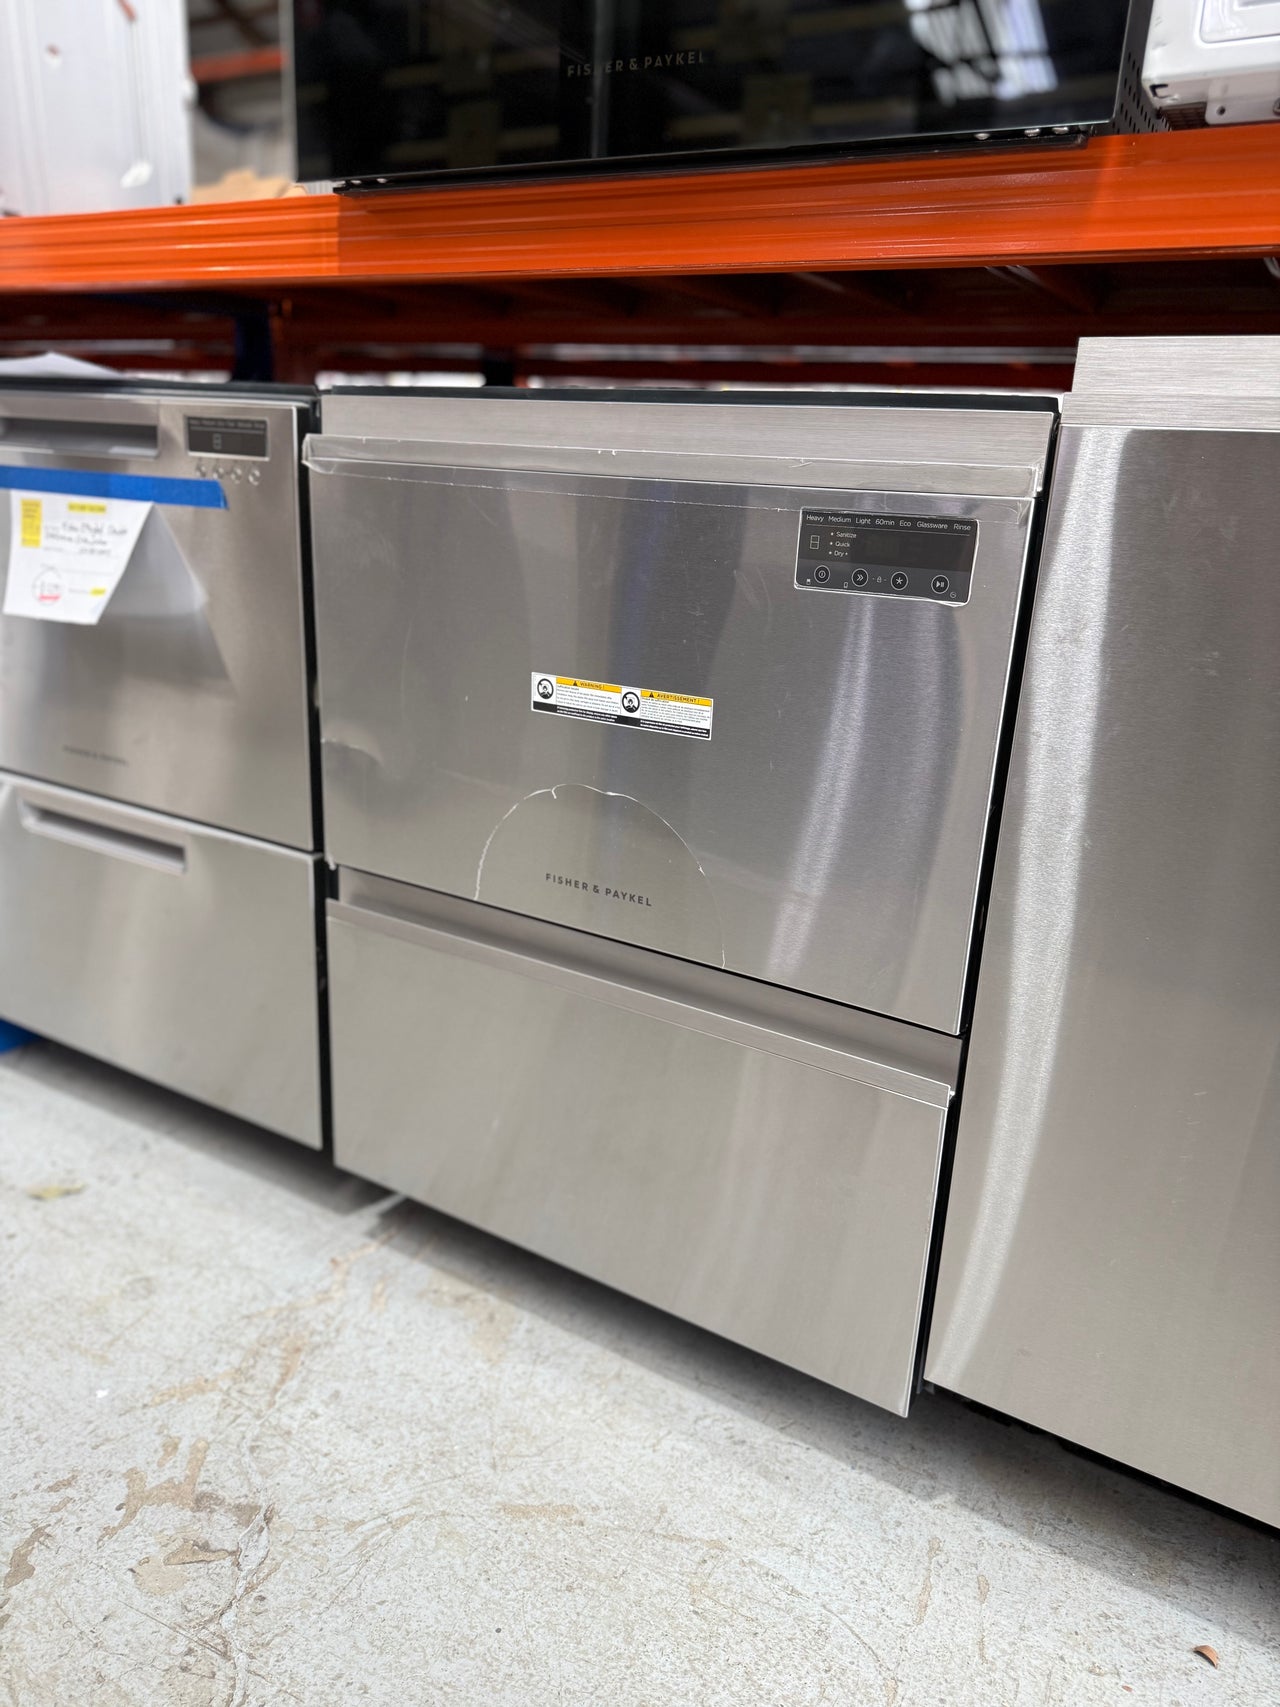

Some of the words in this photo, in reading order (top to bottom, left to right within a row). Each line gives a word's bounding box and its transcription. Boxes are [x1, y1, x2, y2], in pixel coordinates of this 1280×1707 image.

[567, 59, 623, 77] FISER
[629, 57, 639, 71] &
[644, 51, 704, 69] PAYKEL
[806, 514, 825, 523] Heavy
[828, 515, 852, 523] Medium
[875, 518, 895, 526] 60min
[899, 519, 912, 527] Eco
[916, 520, 948, 530] Glassware
[953, 523, 971, 531] Rinse
[836, 531, 857, 539] Sanitize
[835, 540, 850, 548] Quick
[545, 873, 589, 891] FISHER
[592, 884, 600, 894] &
[605, 887, 652, 907] PAYKEL
